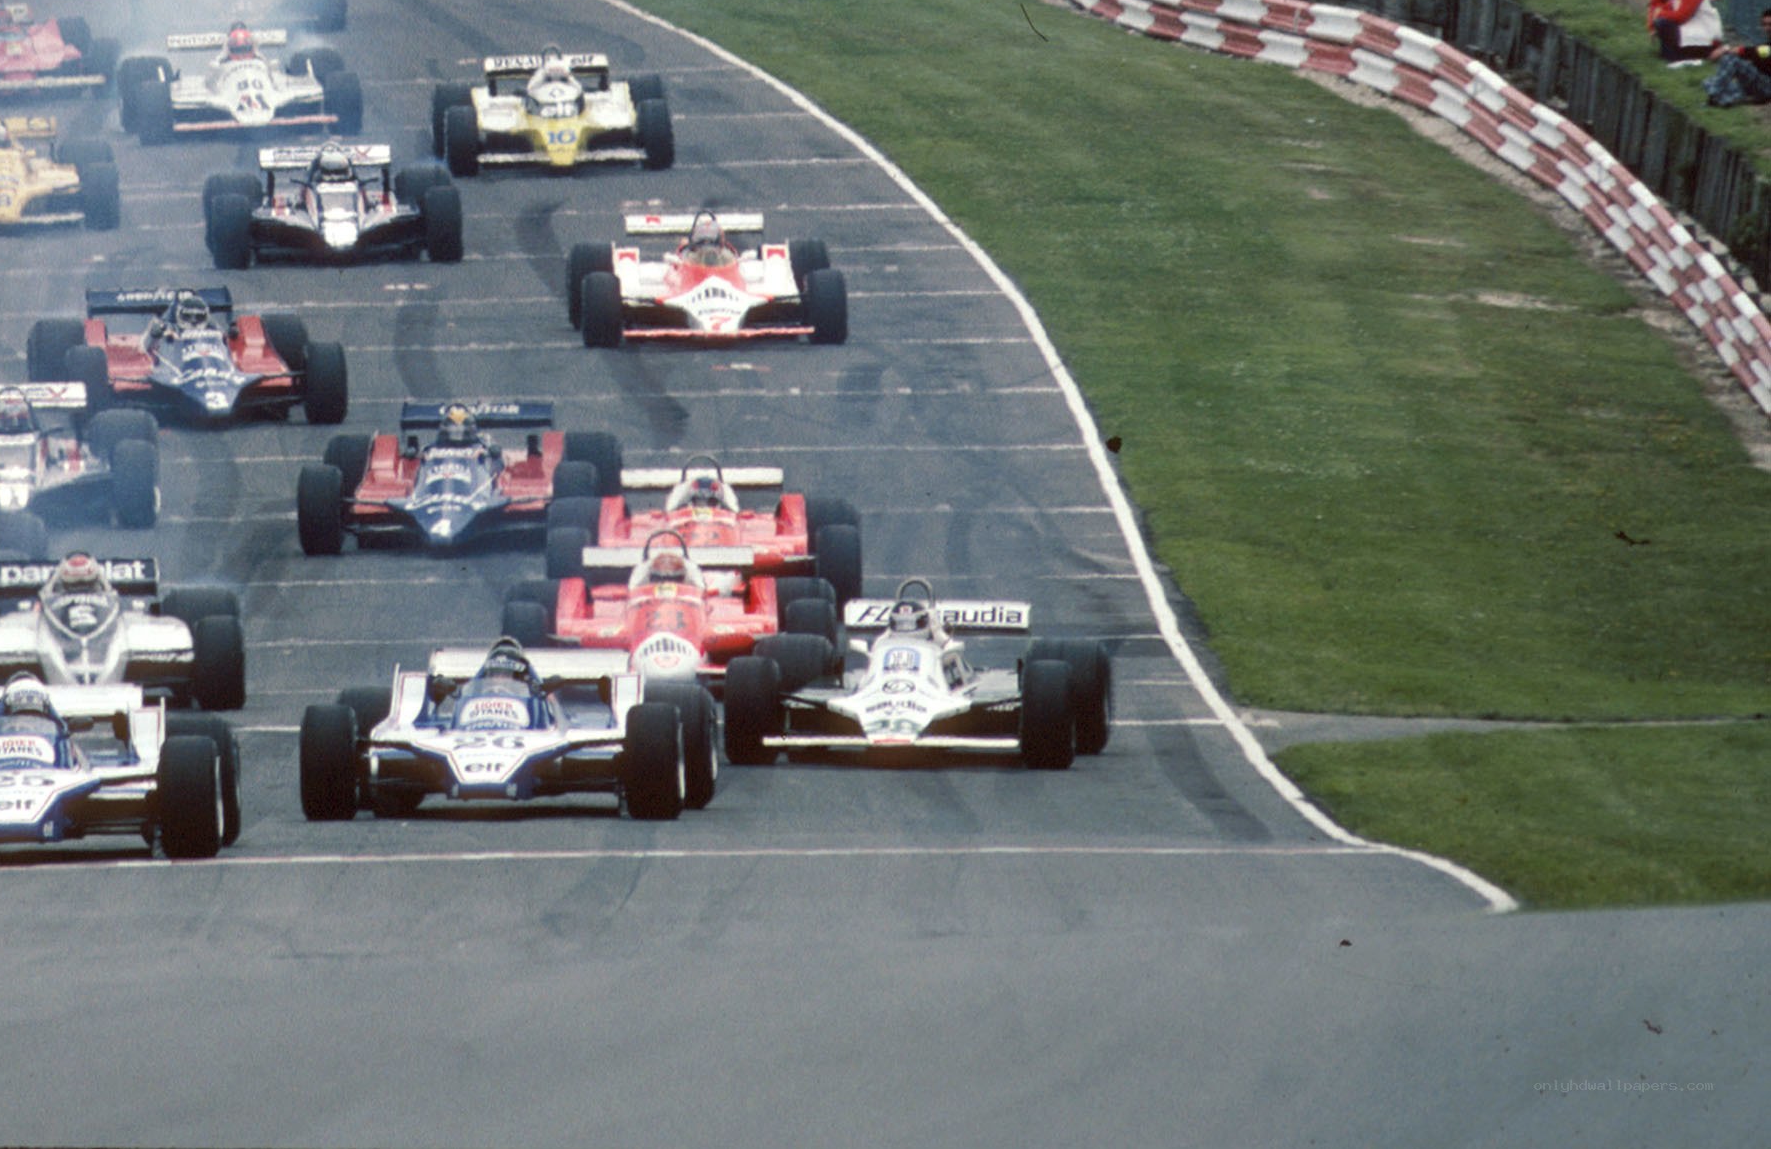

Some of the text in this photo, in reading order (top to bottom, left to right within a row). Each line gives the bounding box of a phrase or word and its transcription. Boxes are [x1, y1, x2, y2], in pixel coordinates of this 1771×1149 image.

[709, 315, 732, 331] 7
[429, 518, 452, 538] 4
[0, 560, 146, 585] parlat
[857, 605, 1022, 624] FL audia
[452, 736, 526, 751] 26
[464, 762, 505, 773] elf
